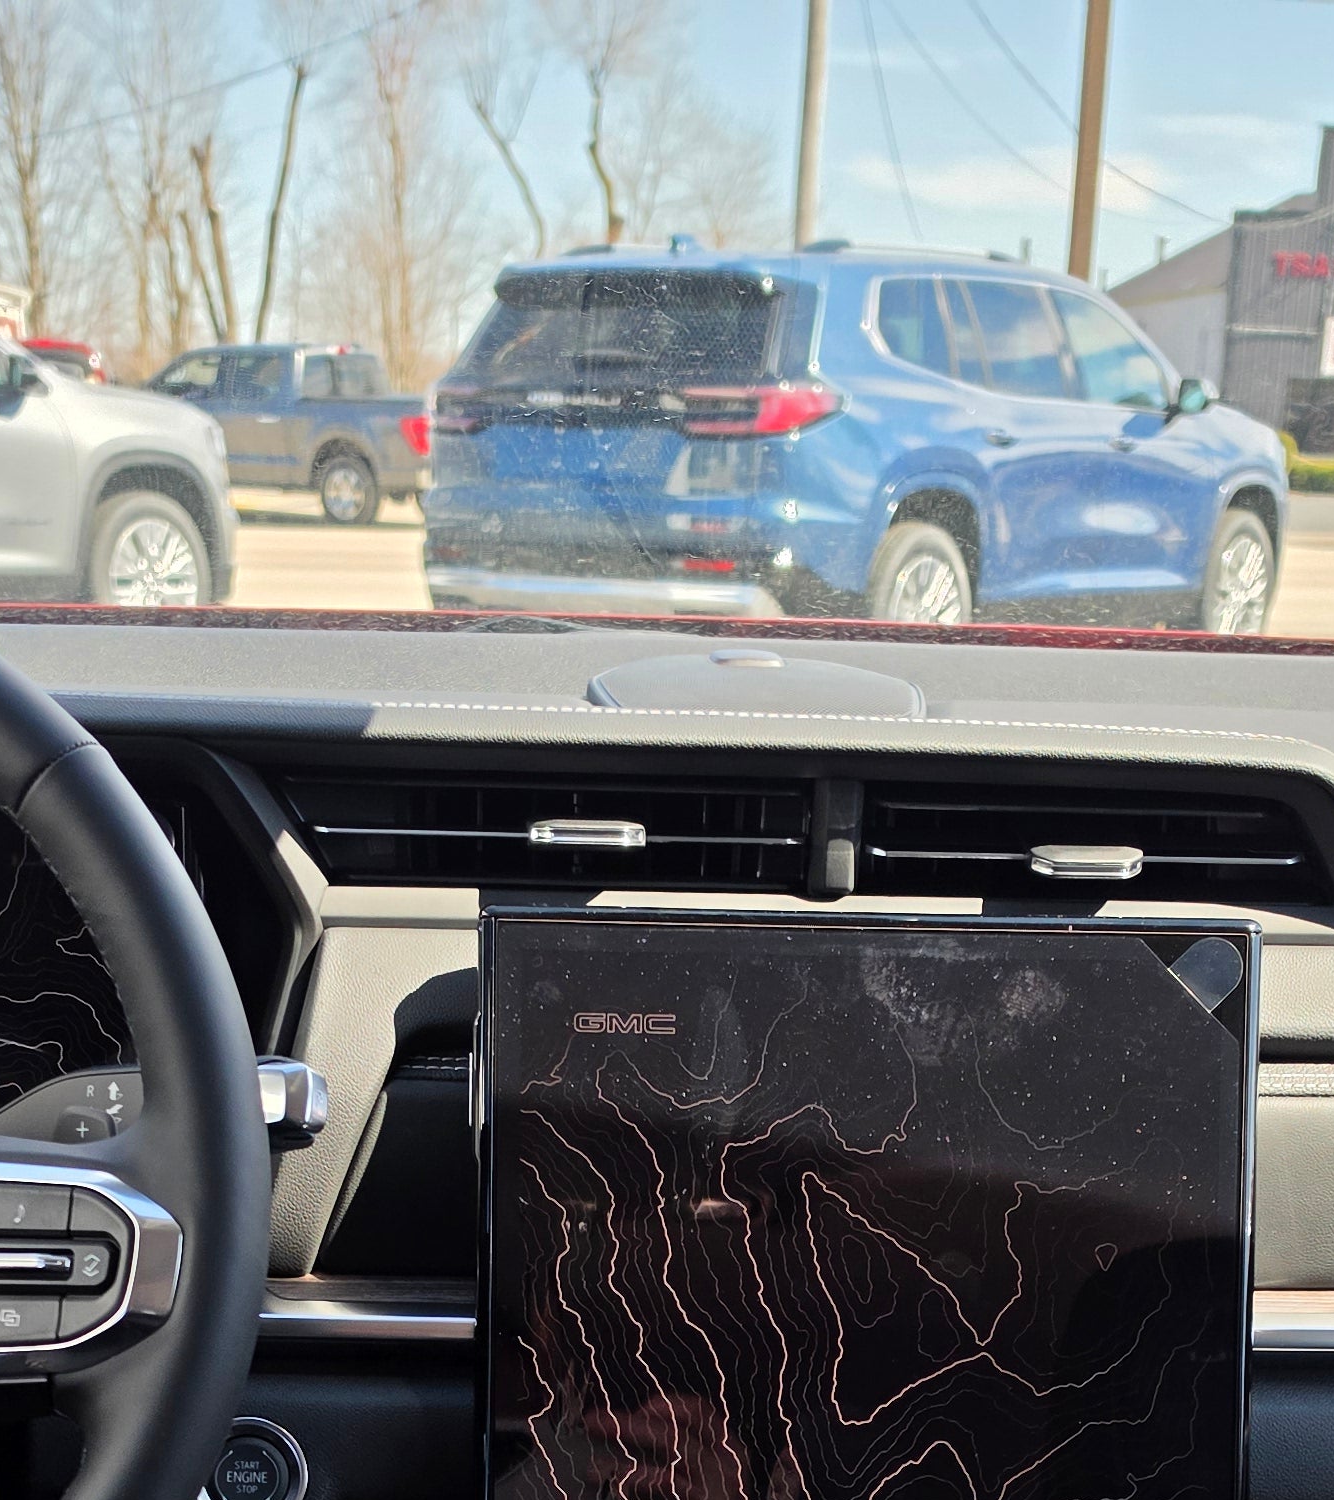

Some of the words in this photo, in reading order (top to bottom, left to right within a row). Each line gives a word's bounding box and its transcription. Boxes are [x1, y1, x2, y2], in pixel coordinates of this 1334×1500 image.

[573, 1012, 677, 1035] GMC
[86, 1084, 95, 1098] R
[235, 1460, 259, 1470] START
[226, 1471, 268, 1484] ENGINE
[236, 1485, 258, 1494] STOP
